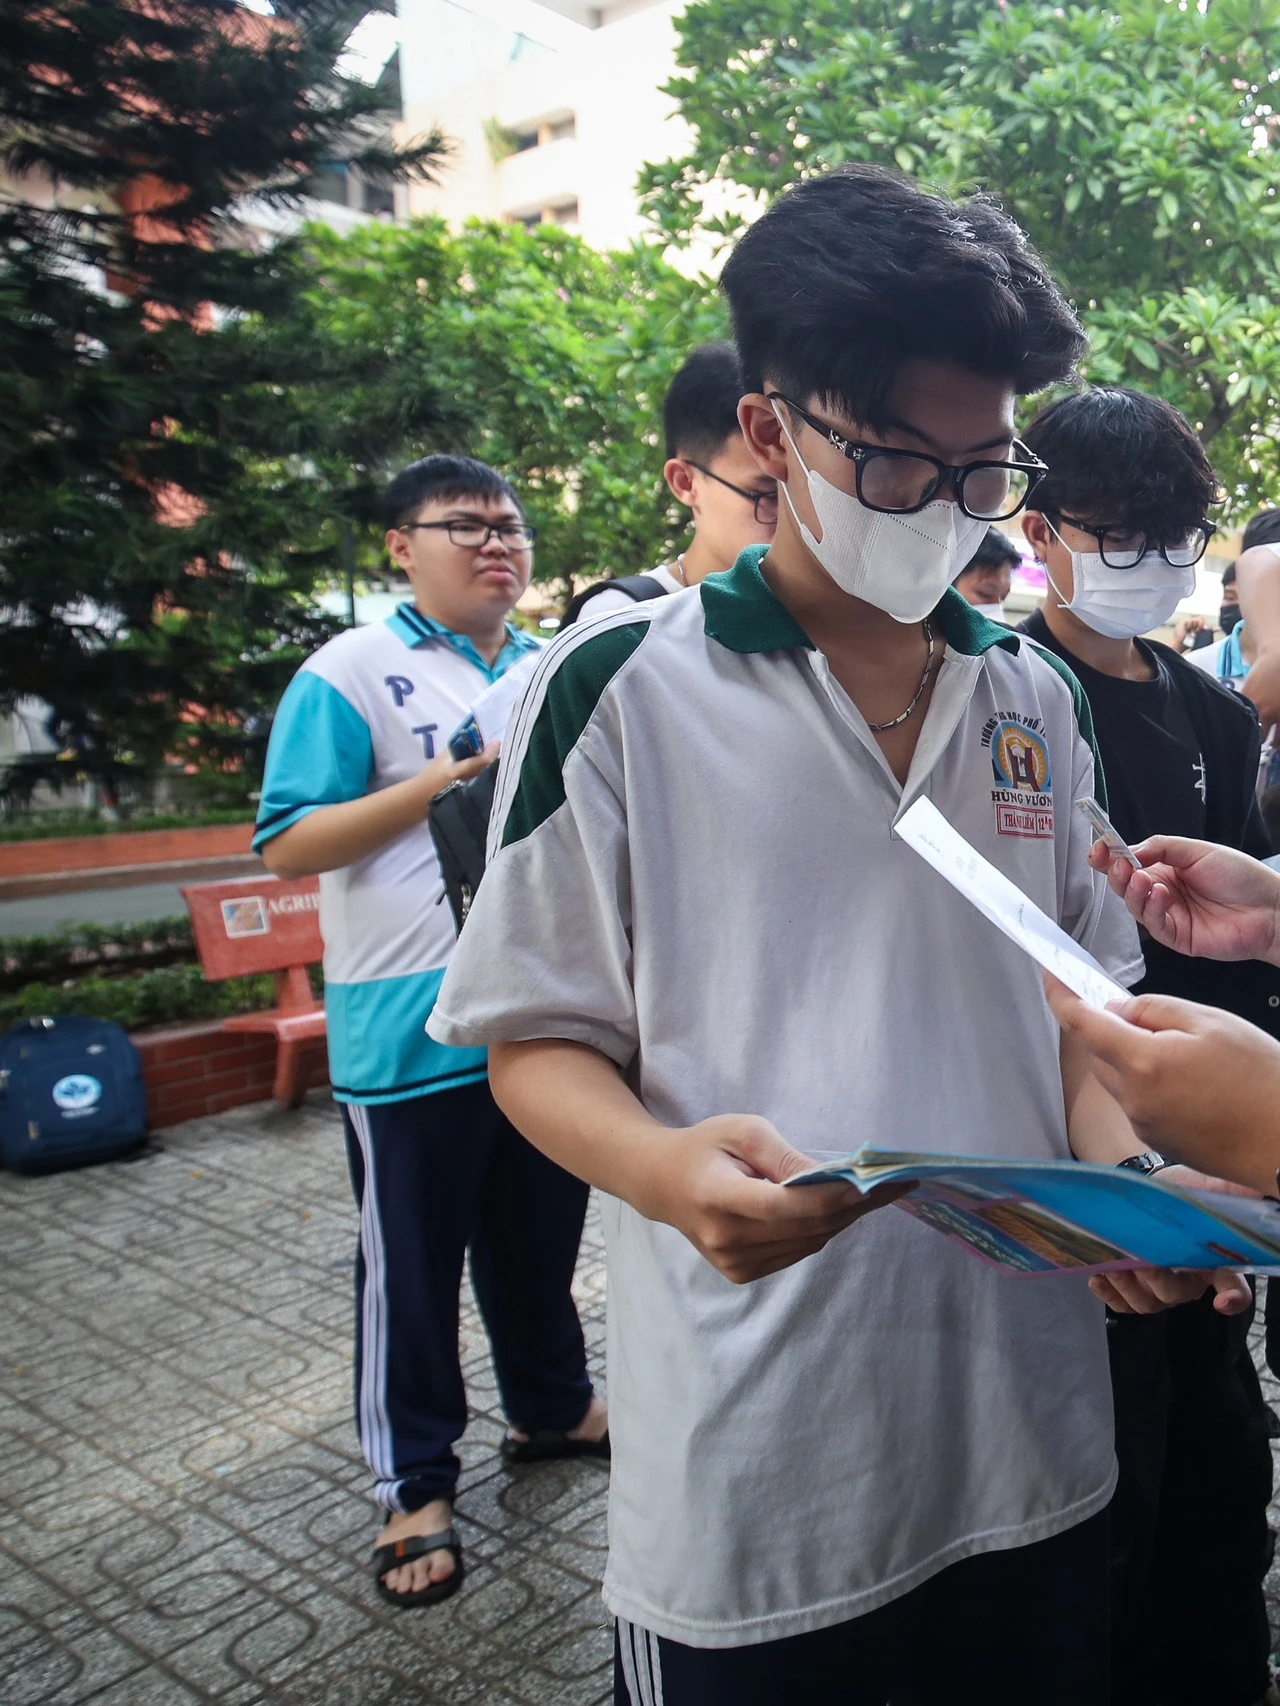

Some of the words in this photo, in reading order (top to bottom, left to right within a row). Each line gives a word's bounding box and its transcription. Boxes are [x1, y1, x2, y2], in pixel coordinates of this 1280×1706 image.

[384, 675, 414, 707] P
[411, 723, 438, 760] T
[991, 789, 1023, 804] HÙNG
[1025, 794, 1053, 807] VƯƠN
